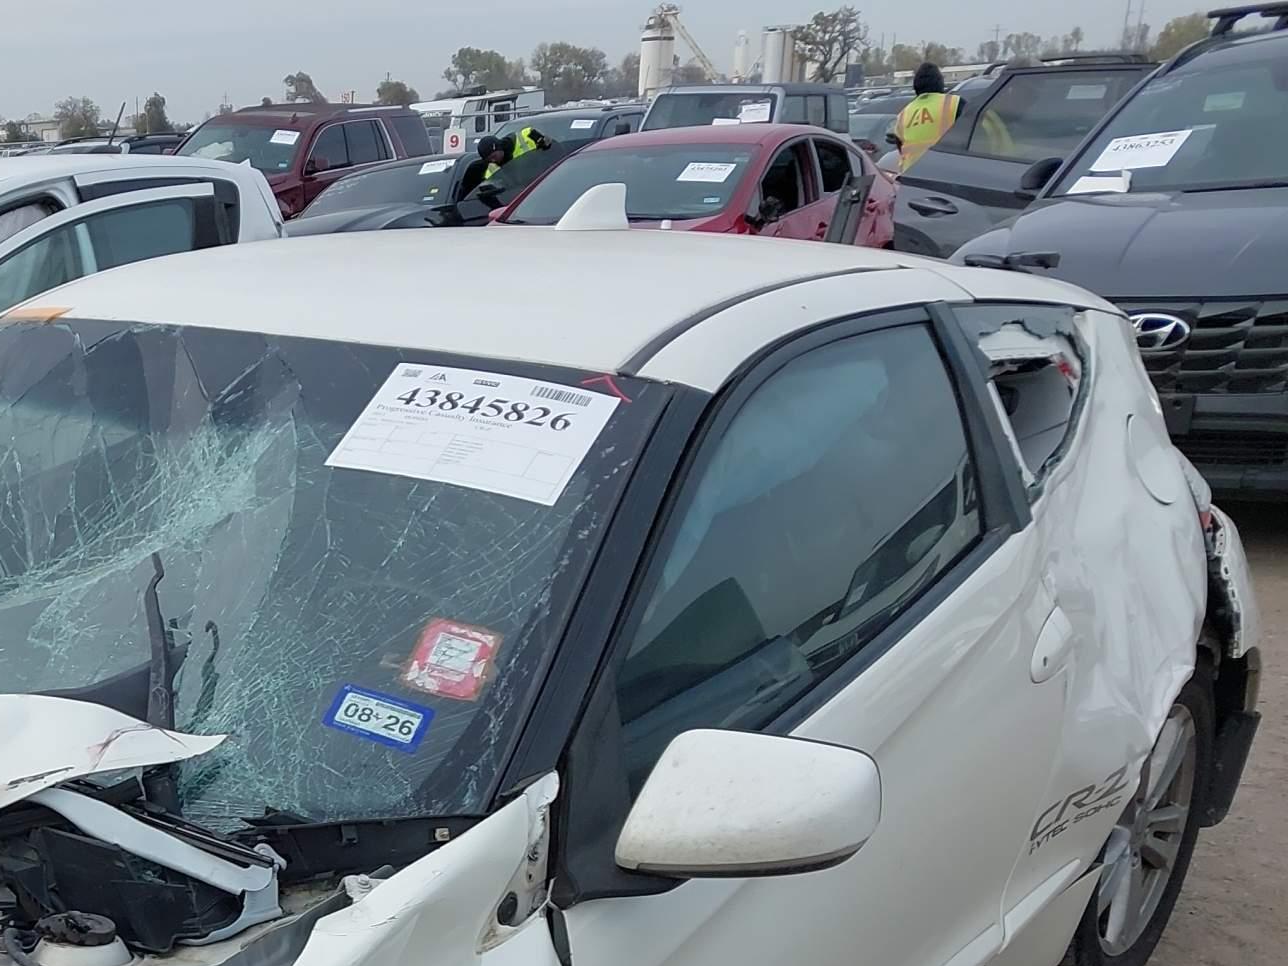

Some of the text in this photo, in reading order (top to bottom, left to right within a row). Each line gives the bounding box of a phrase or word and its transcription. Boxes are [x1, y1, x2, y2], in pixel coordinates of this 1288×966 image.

[450, 134, 459, 148] 9
[376, 403, 428, 416] Progressive
[468, 415, 513, 429] Insurance
[396, 387, 580, 431] 43845826
[343, 702, 373, 723] 08
[382, 714, 415, 736] 26
